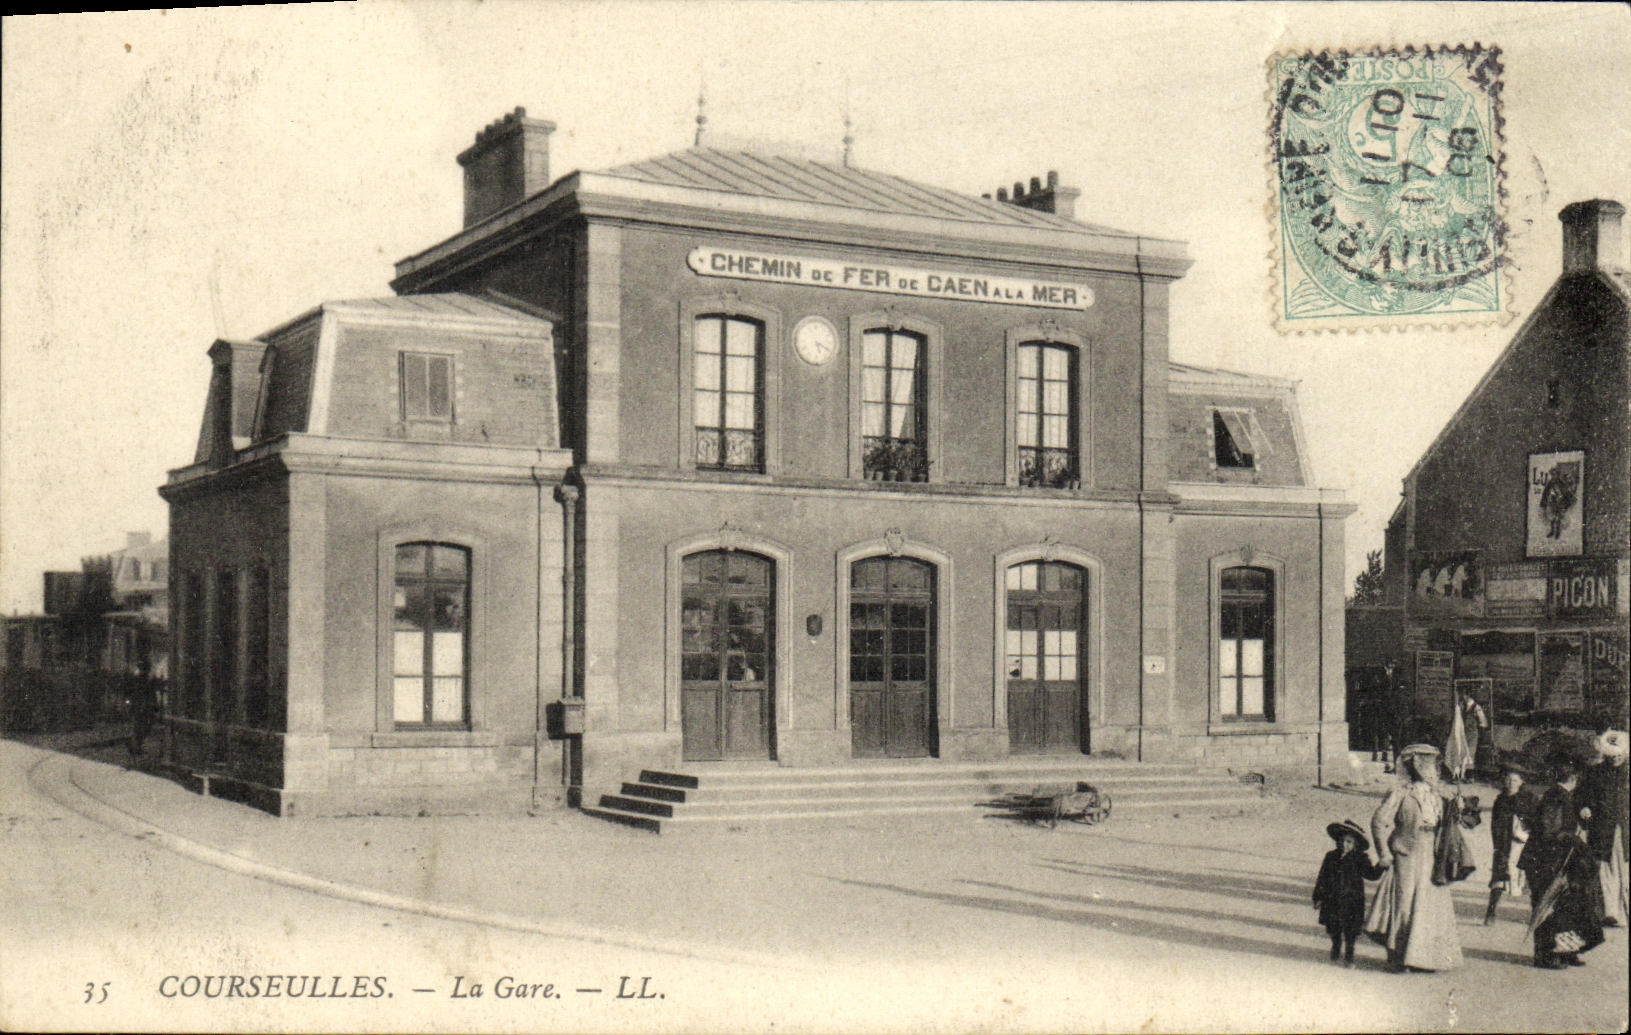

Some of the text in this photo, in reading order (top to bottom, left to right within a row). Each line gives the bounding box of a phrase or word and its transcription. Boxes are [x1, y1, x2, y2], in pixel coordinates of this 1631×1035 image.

[710, 252, 802, 279] CHEMIN
[811, 269, 833, 283] DE
[843, 266, 890, 288] FER
[898, 278, 919, 291] DE
[927, 275, 989, 297] CAEN
[1032, 284, 1077, 305] MER
[1552, 575, 1609, 608] PICON
